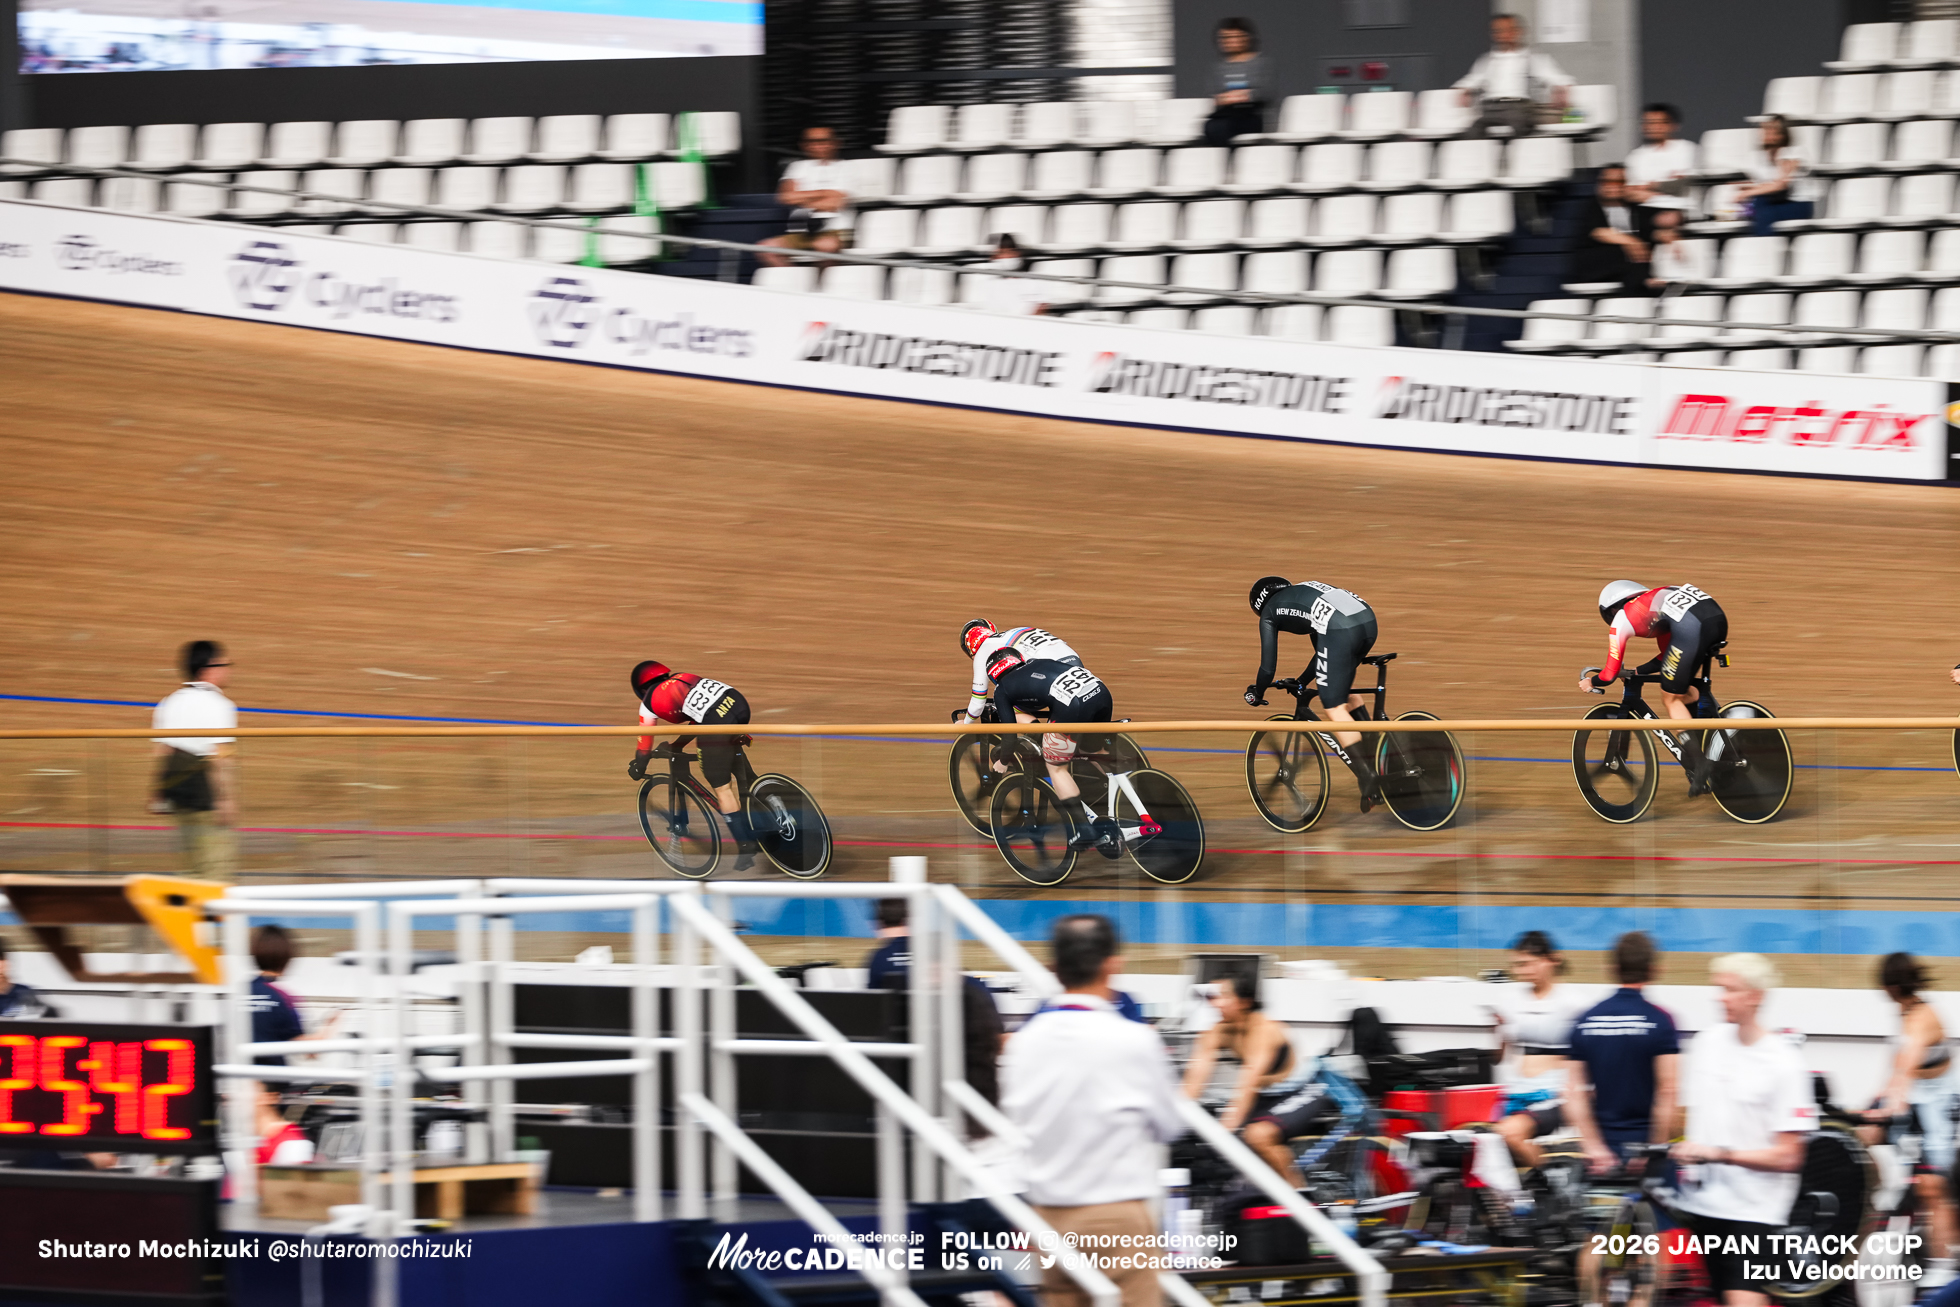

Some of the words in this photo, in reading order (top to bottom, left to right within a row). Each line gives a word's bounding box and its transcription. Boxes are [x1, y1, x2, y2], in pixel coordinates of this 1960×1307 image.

[1254, 588, 1269, 610] KASK
[1668, 593, 1691, 610] 132
[1276, 607, 1289, 616] NEW
[1290, 608, 1312, 621] ZEALAN
[1313, 601, 1332, 621] 137
[1023, 632, 1048, 647] 141
[1316, 647, 1328, 687] NZL
[1056, 674, 1081, 695] 142
[687, 690, 710, 711] 133
[715, 696, 736, 718] ANTA
